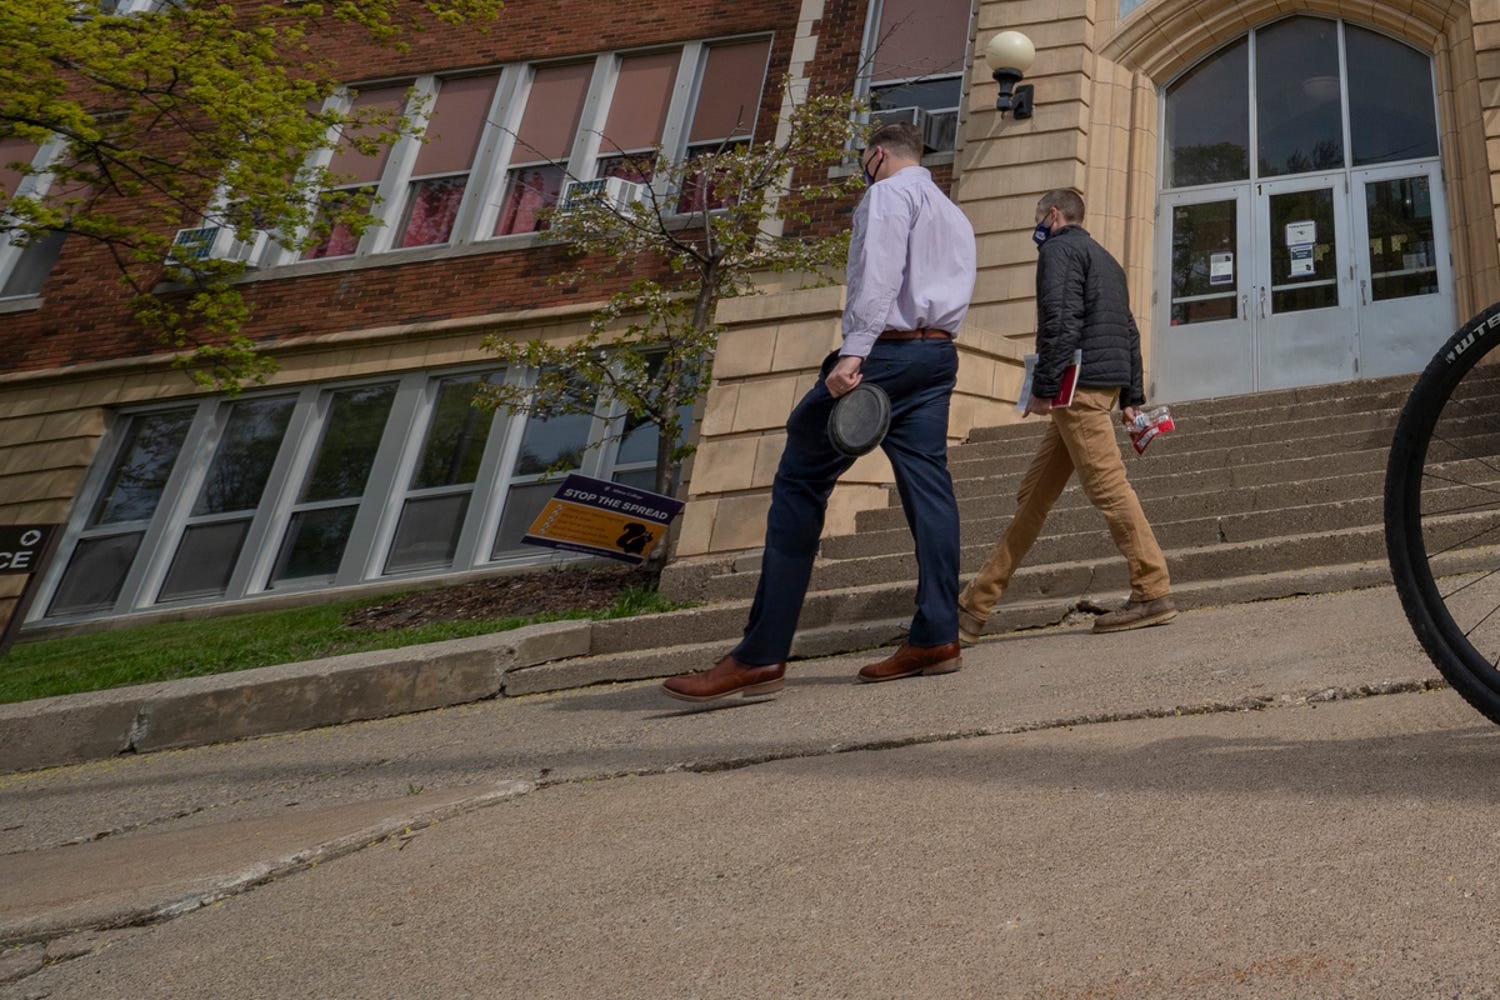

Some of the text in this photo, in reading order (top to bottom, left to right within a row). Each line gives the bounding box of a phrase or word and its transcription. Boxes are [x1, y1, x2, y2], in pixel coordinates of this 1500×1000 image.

[1257, 184, 1262, 196] 1
[564, 488, 597, 503] STOP
[599, 495, 620, 508] THE
[622, 502, 668, 520] SPREAD
